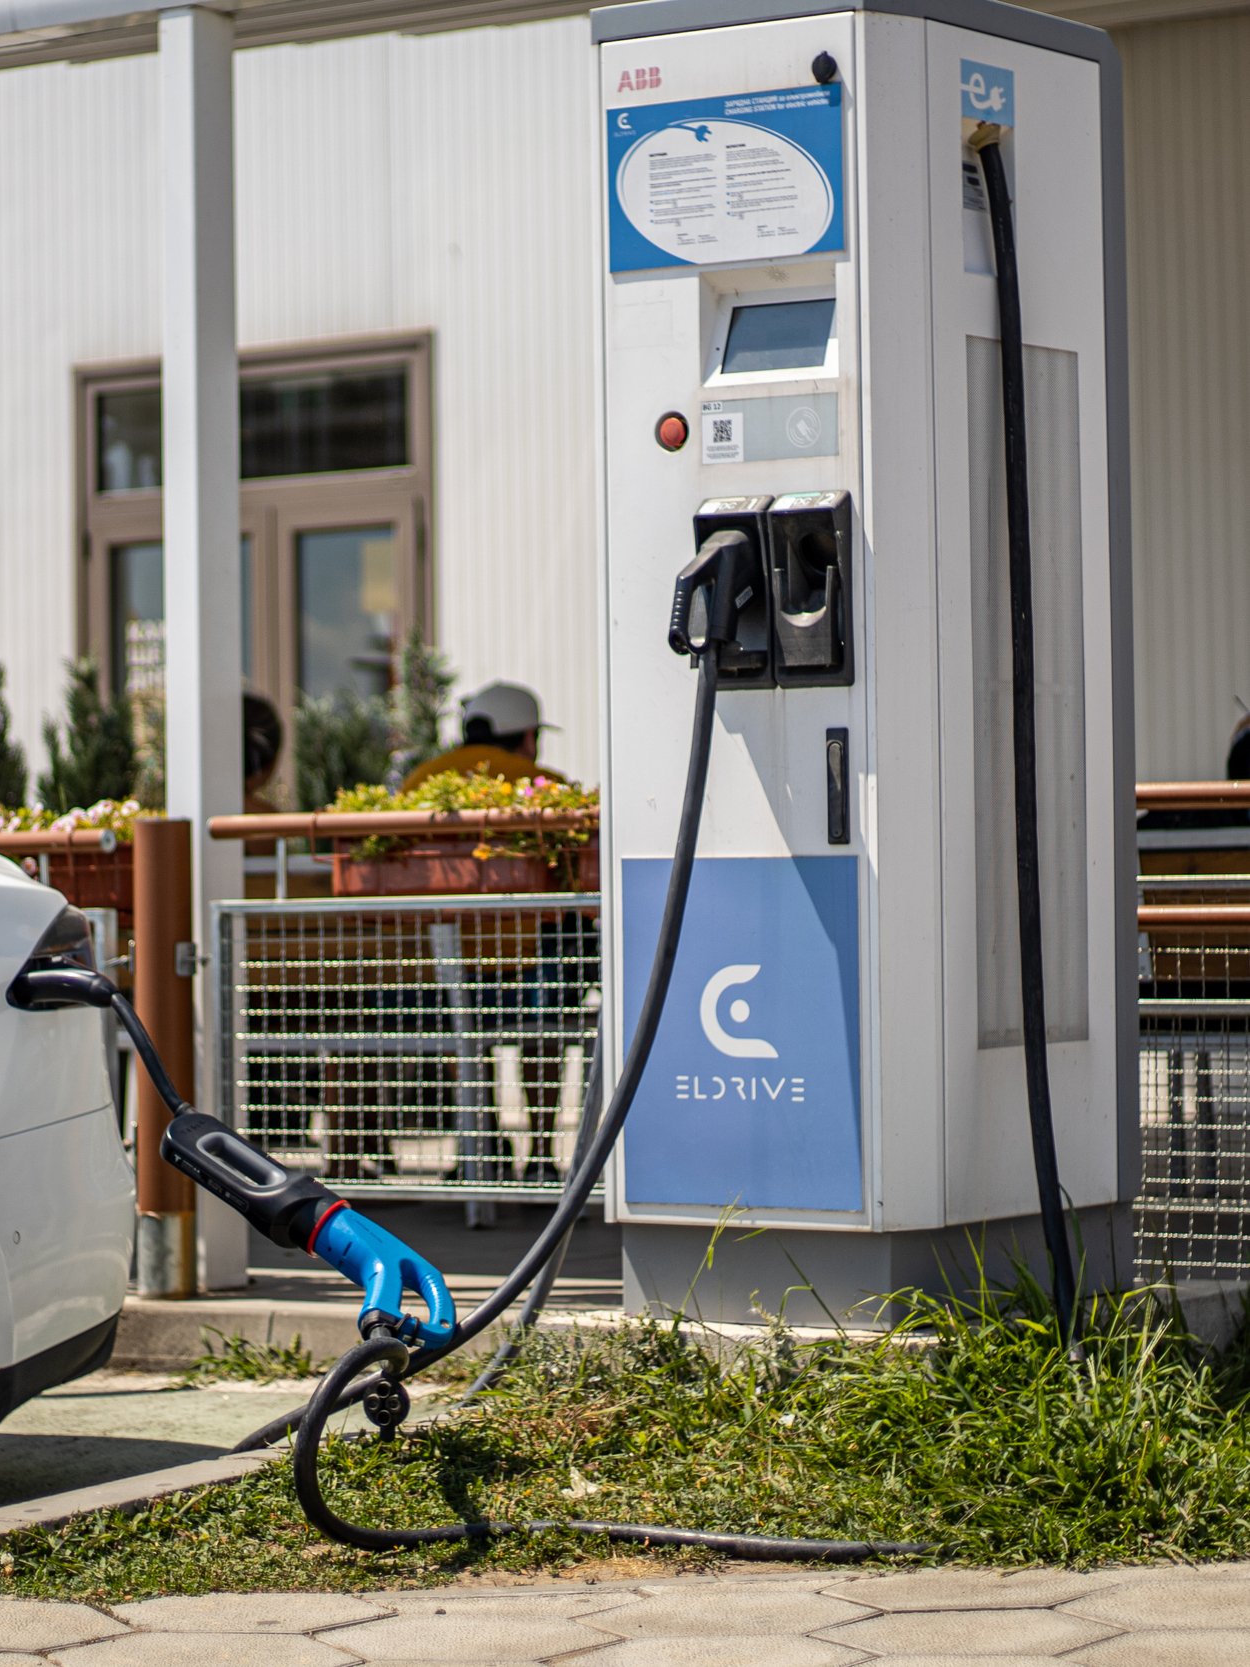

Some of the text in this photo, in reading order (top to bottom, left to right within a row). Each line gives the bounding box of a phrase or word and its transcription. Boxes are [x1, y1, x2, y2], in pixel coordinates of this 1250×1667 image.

[617, 66, 662, 93] ABB
[748, 498, 759, 511] 1
[819, 492, 836, 506] 2
[676, 1075, 805, 1102] ELDRIVE
